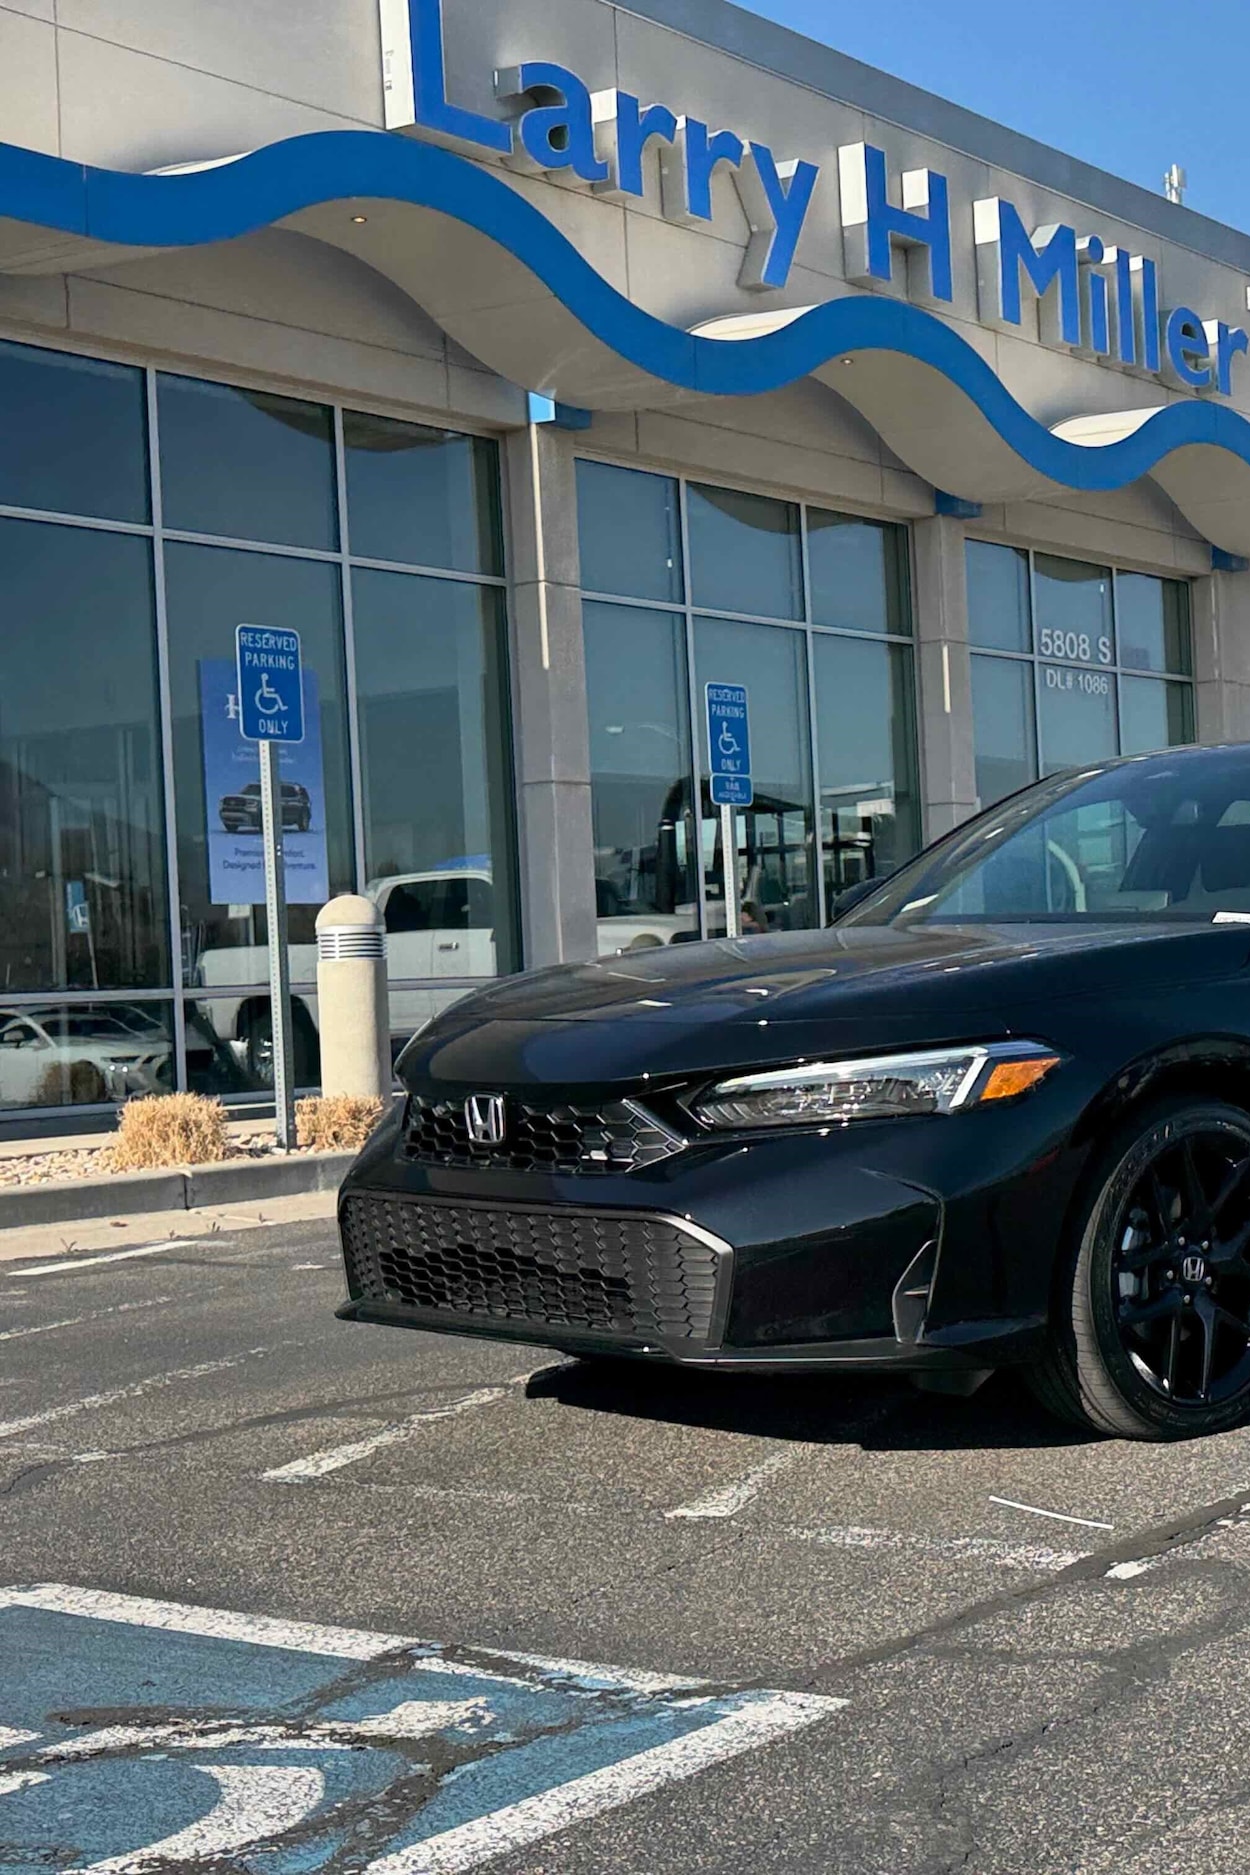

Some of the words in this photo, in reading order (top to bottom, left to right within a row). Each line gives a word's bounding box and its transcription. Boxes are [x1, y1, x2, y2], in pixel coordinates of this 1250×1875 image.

[404, 0, 819, 290] Larry
[863, 142, 953, 303] H
[999, 199, 1250, 396] Miller
[240, 631, 297, 651] RESERVED
[1040, 628, 1091, 660] 5808
[1098, 636, 1111, 663] S
[244, 651, 295, 670] PARKING
[1078, 673, 1108, 695] 1086
[709, 689, 745, 703] RESERVED
[712, 704, 744, 718] PARKING
[258, 718, 289, 734] ONLY
[721, 759, 740, 771] ONLY
